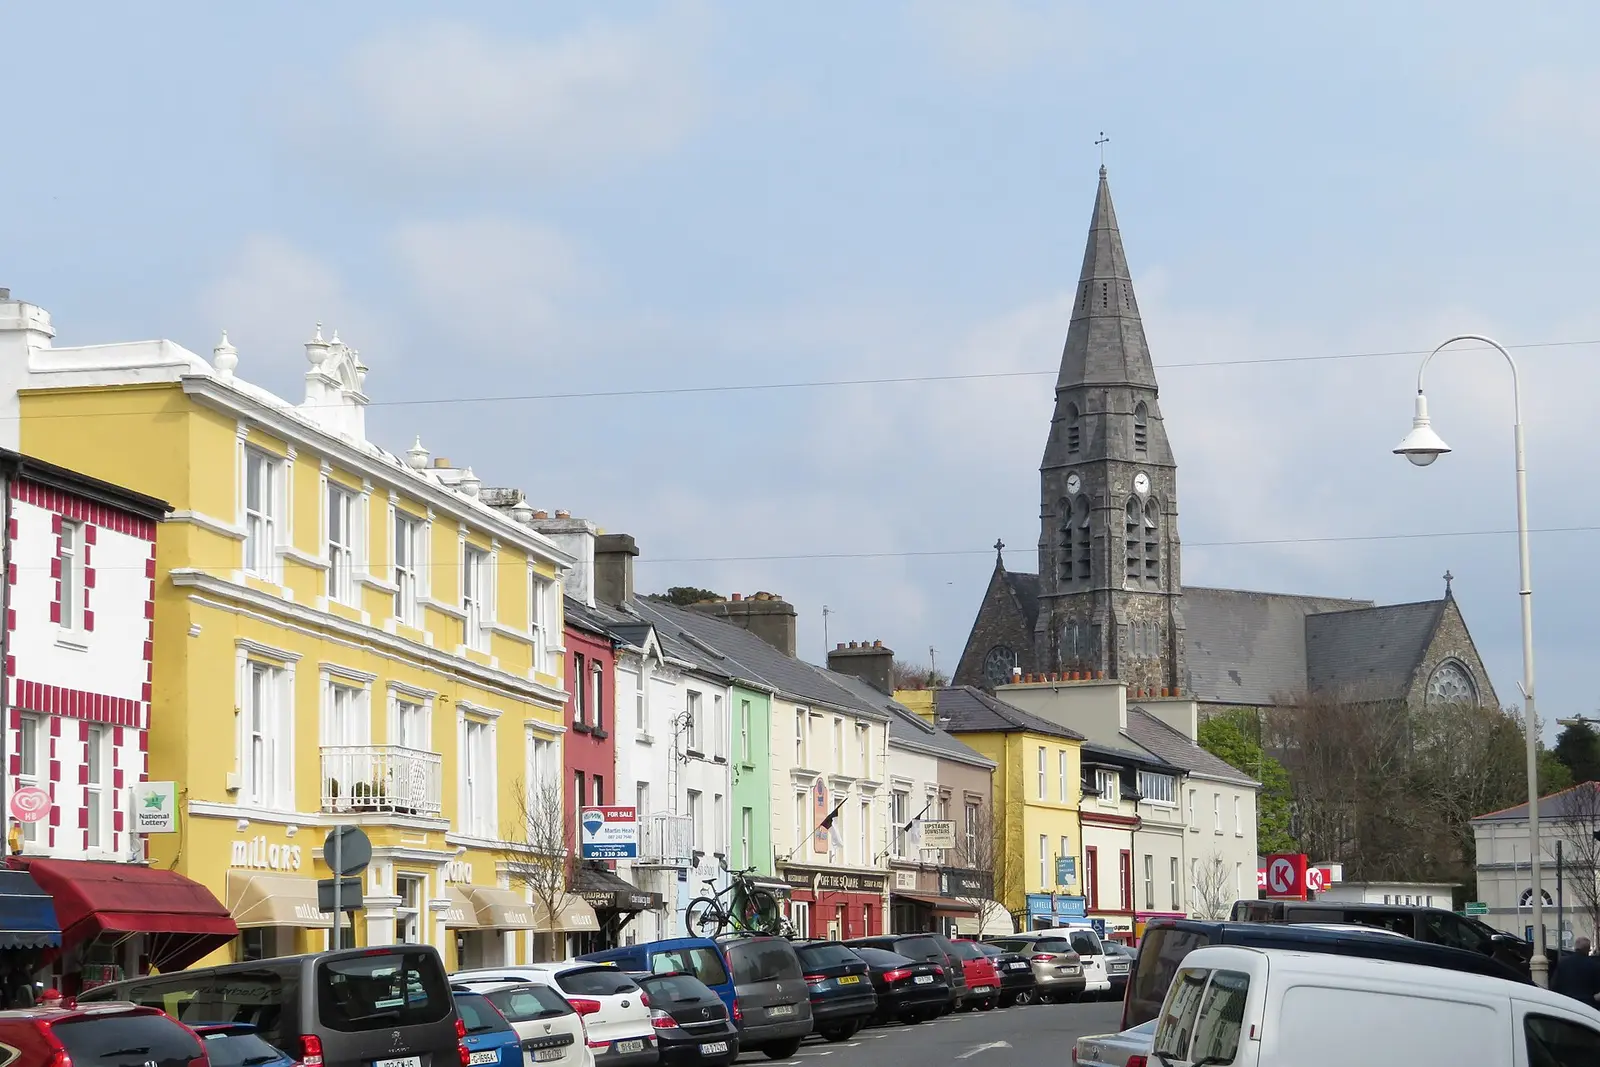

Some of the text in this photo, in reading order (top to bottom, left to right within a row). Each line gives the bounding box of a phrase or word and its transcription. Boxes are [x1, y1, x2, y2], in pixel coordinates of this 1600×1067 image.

[24, 812, 37, 821] HB
[141, 819, 168, 827] Lottery
[231, 836, 300, 870] millars
[821, 875, 859, 890] OFF THE SQUARE
[527, 1041, 554, 1049] LOGAN
